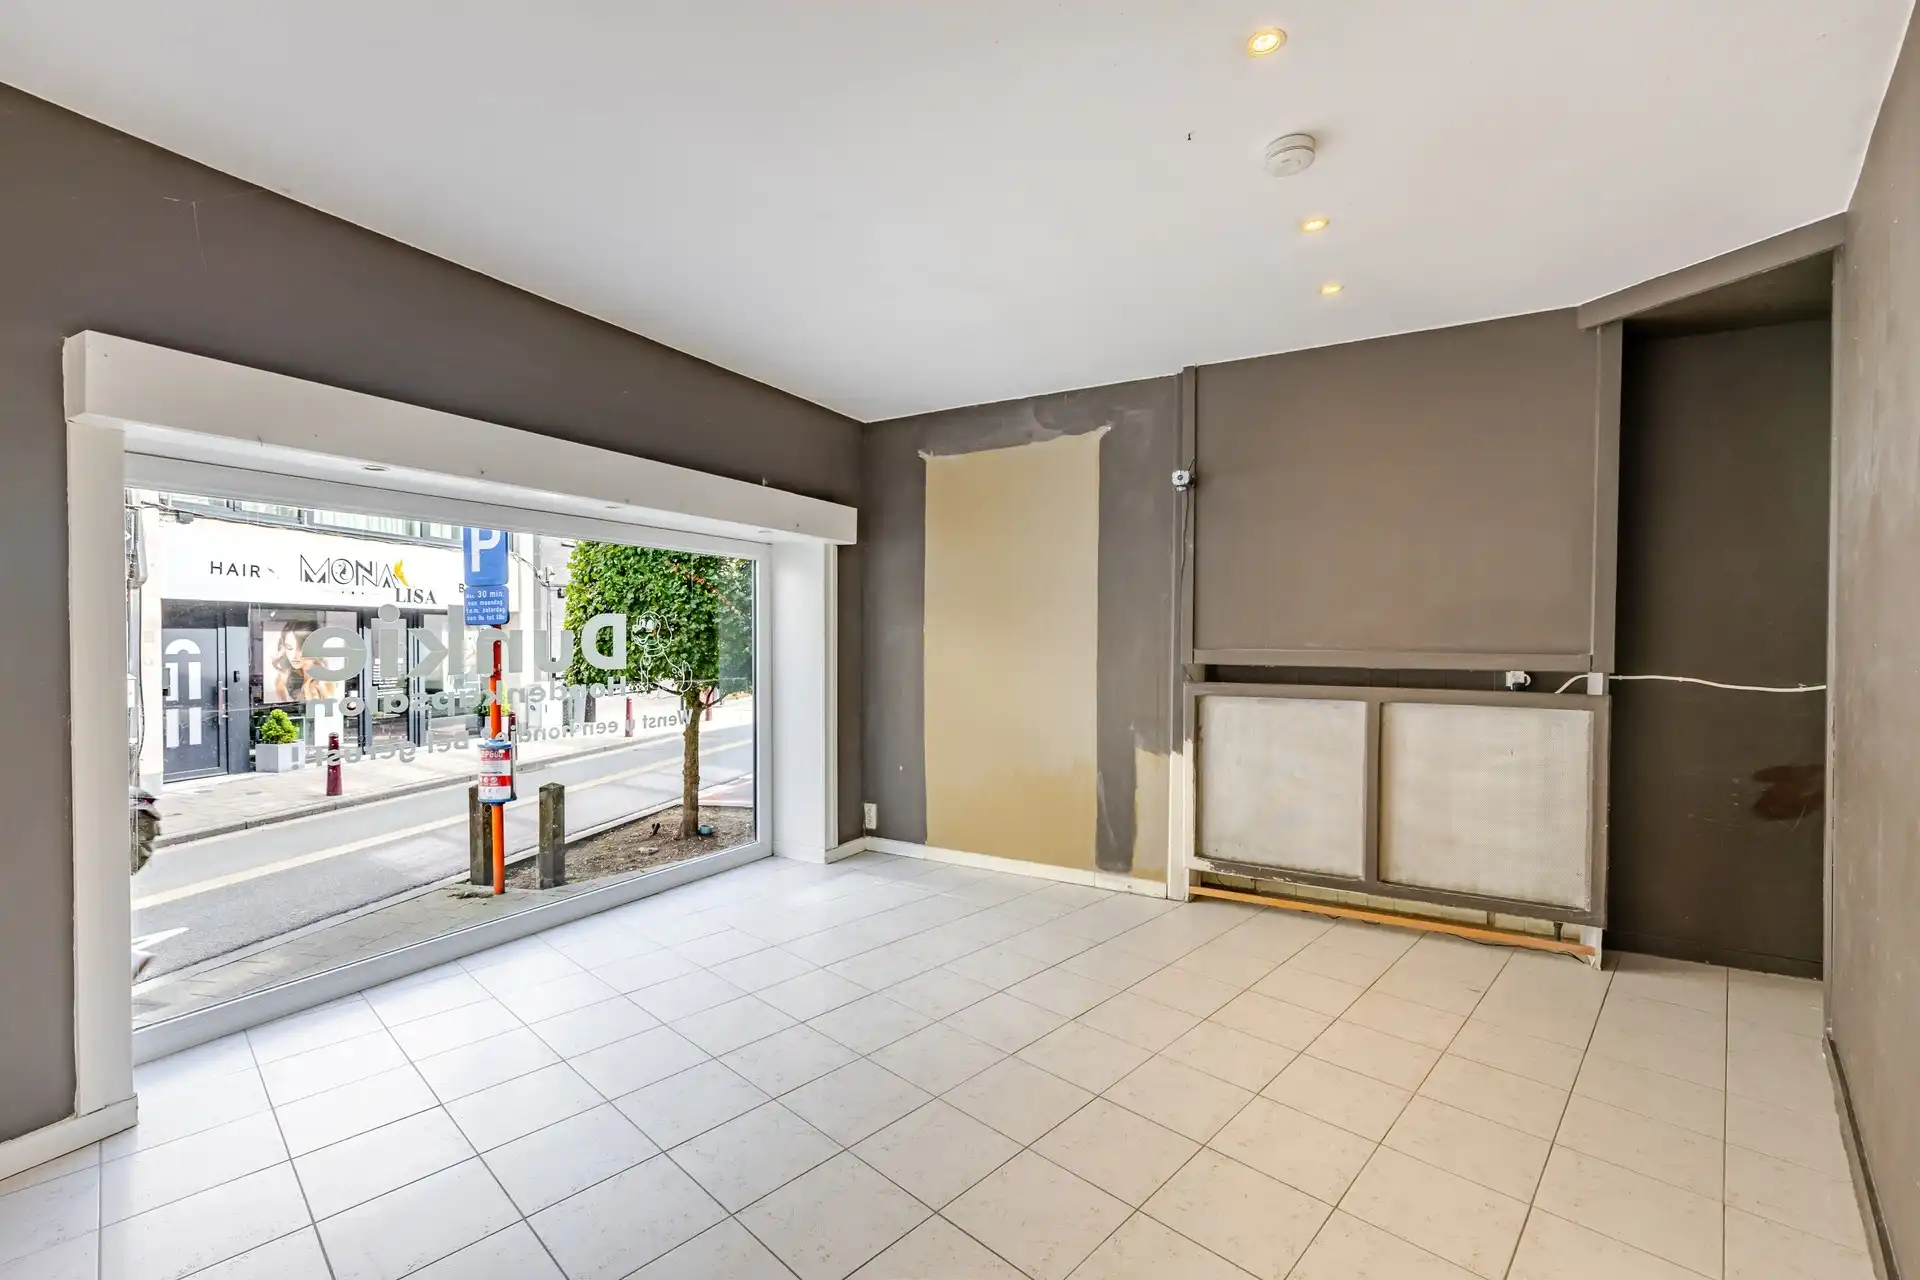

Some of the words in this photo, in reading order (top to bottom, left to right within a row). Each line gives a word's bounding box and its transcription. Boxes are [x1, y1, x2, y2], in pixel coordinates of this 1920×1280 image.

[470, 528, 501, 572] P
[210, 560, 261, 578] HAIR
[300, 554, 398, 588] MONA
[395, 587, 437, 605] LISA
[477, 590, 487, 598] 30
[489, 590, 505, 598] min.
[479, 599, 503, 607] maandag
[482, 606, 505, 614] zaterdag
